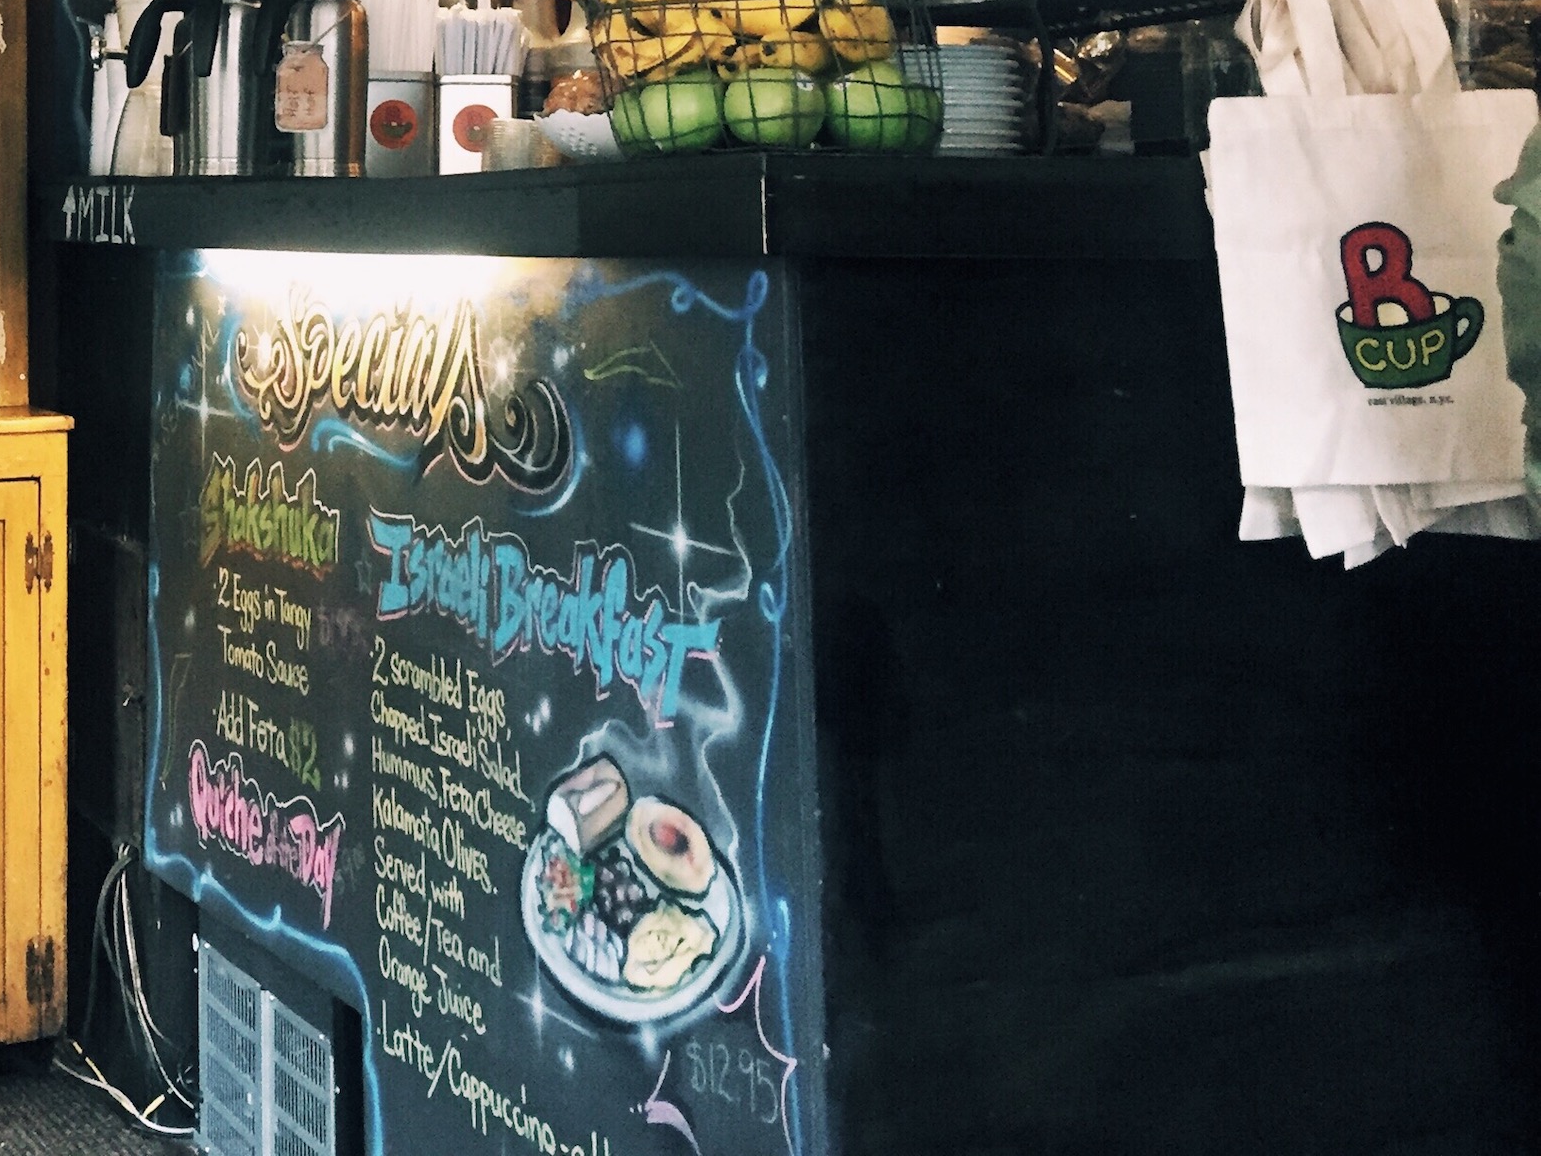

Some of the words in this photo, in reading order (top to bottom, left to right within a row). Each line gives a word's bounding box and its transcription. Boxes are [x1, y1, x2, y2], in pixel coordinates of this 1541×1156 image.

[1355, 328, 1446, 372] CUP
[217, 567, 231, 606] 2
[232, 571, 260, 631] Eggs
[264, 581, 275, 614] in
[276, 587, 313, 647] Tangy
[367, 515, 491, 646] Israeli
[217, 624, 264, 674] Tomato
[267, 642, 311, 696] Sauce
[372, 634, 388, 685] 2
[390, 656, 463, 715] scrambled
[216, 691, 244, 746] Add
[245, 701, 287, 762] Feta
[369, 697, 430, 746] Chopped
[431, 713, 478, 774] Israeli
[188, 746, 264, 866] Quiche
[289, 814, 341, 930] Day
[370, 790, 441, 860] Kalamata
[472, 794, 528, 852] Cheese
[375, 837, 428, 893] Served
[431, 880, 466, 920] with
[379, 940, 433, 1005] Orange
[436, 971, 487, 1036] Juice
[466, 948, 503, 989] and
